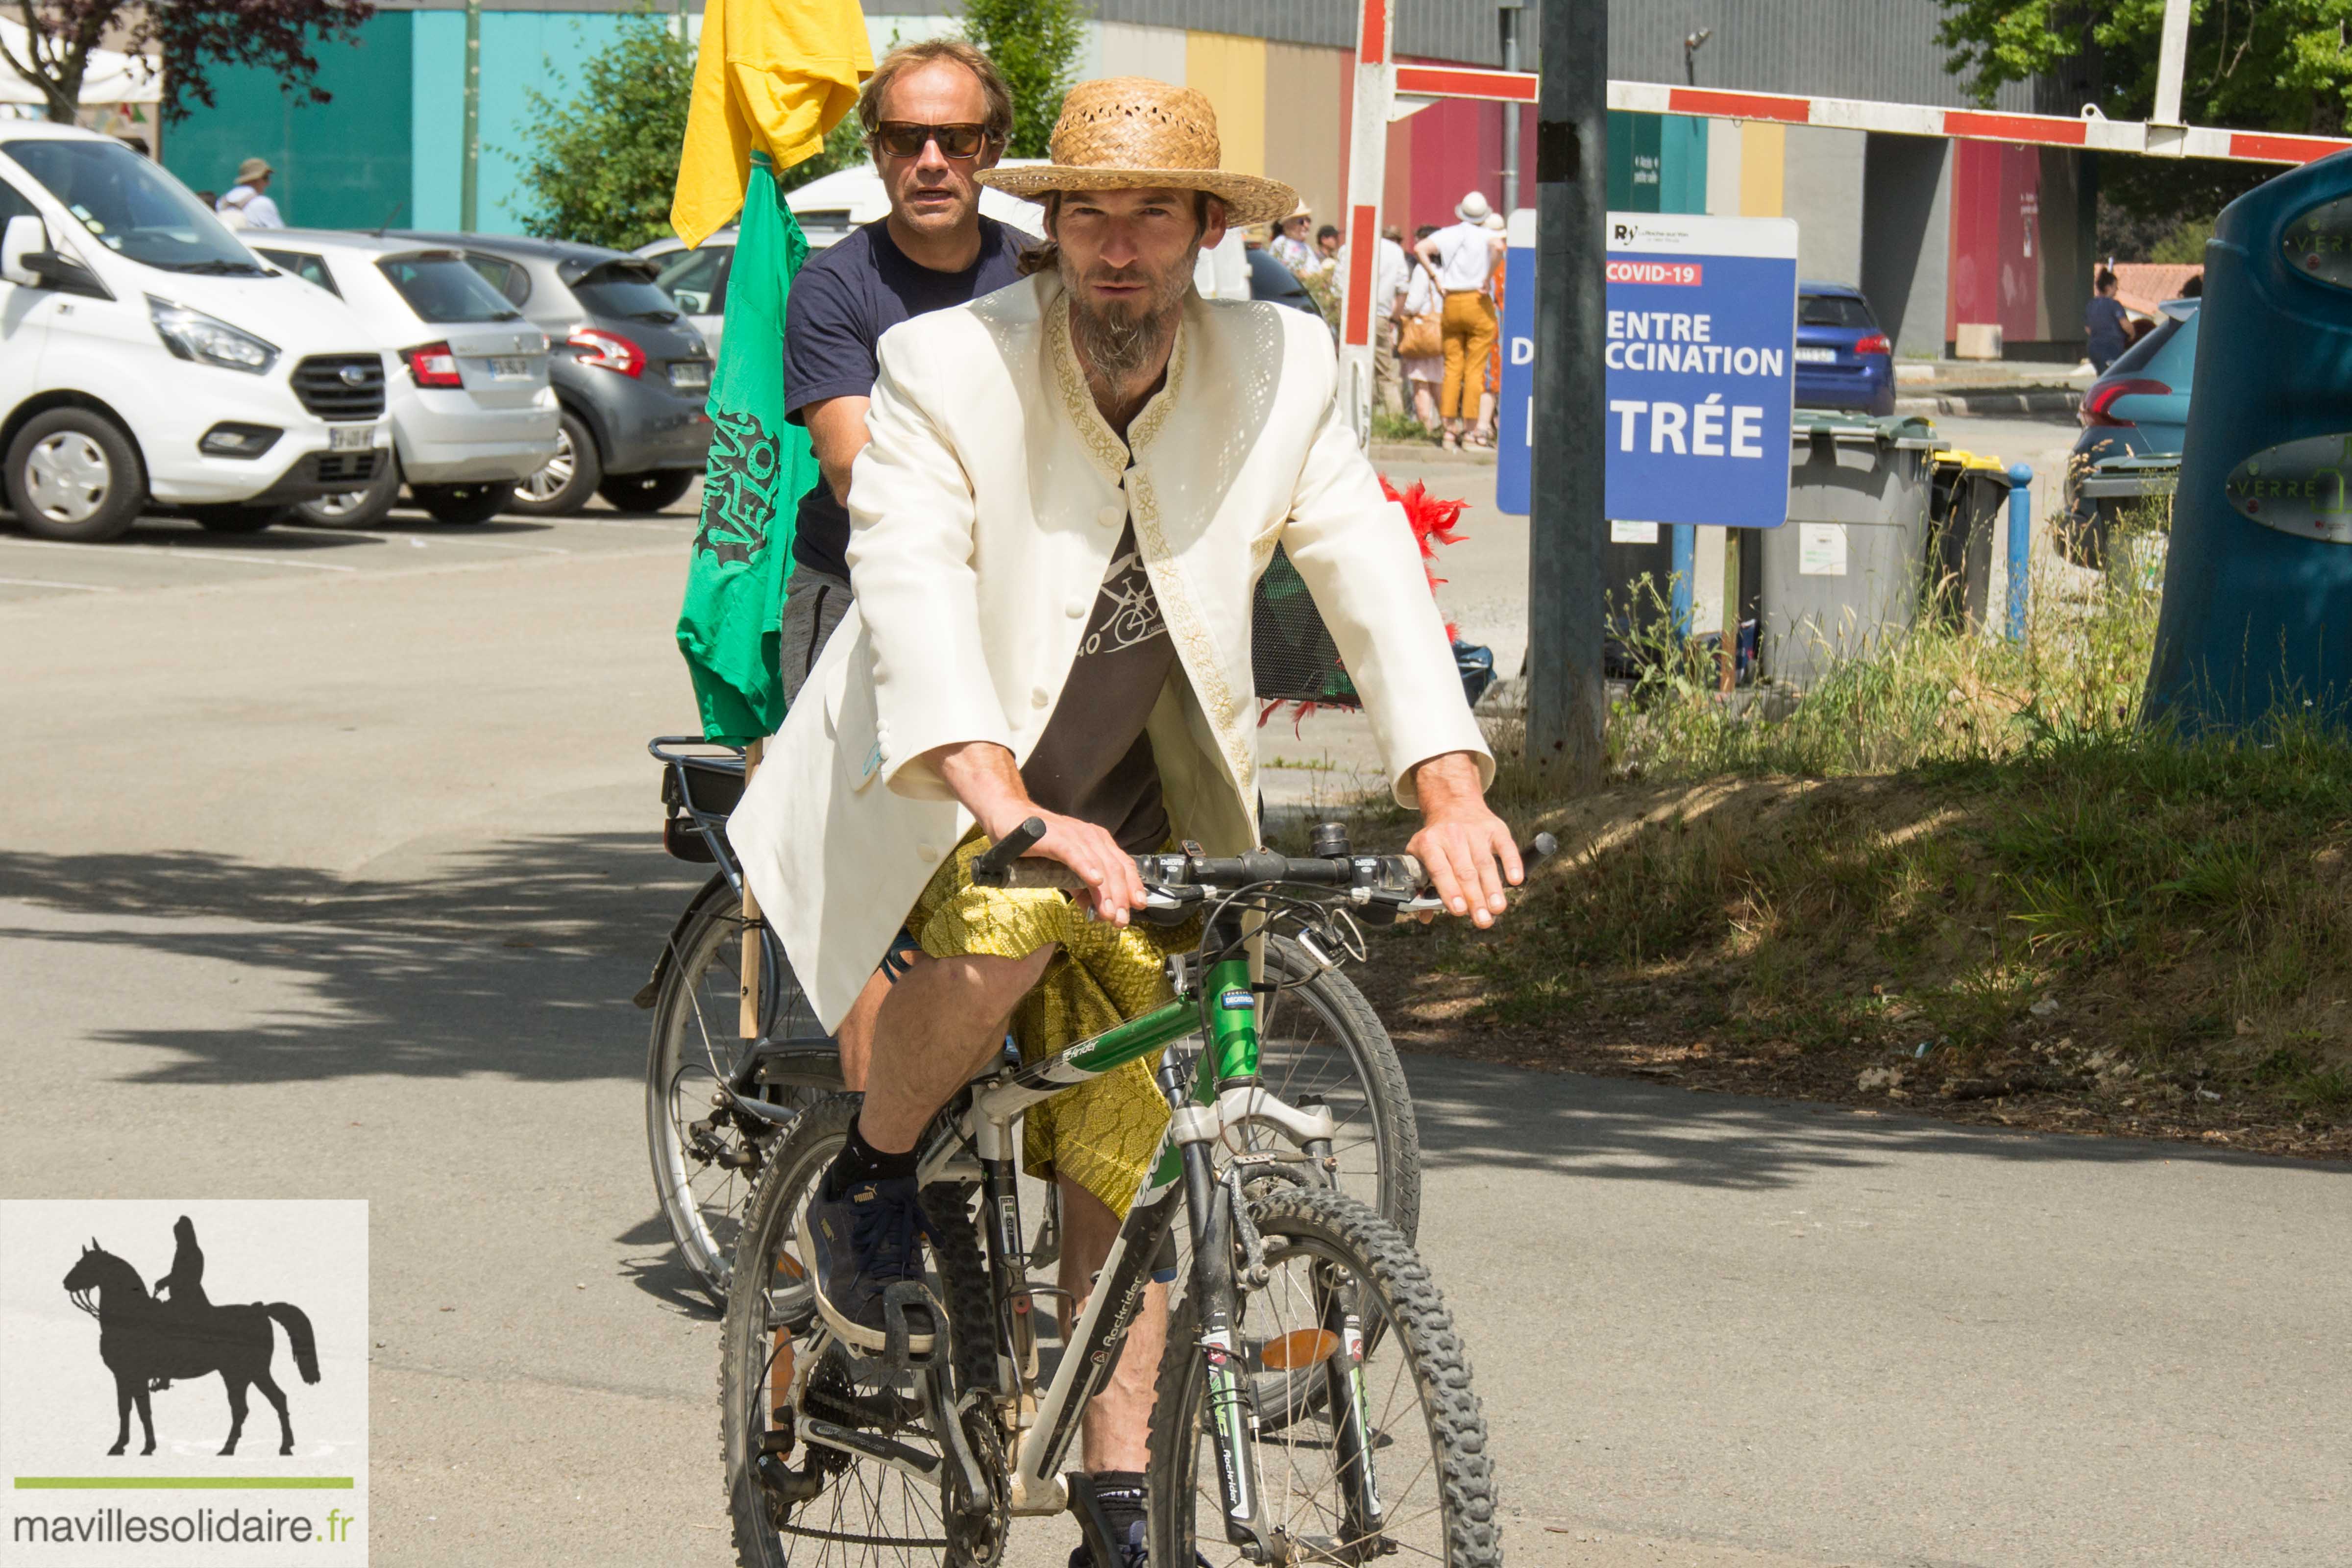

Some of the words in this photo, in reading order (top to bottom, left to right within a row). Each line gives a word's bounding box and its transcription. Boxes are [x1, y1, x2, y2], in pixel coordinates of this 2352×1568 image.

[2295, 235, 2352, 253] VER
[1606, 263, 1694, 283] COVID-19
[1607, 310, 1711, 343] ENTRE
[1511, 337, 1535, 365] D
[1605, 342, 1784, 377] CCINATION
[1525, 393, 1764, 458] TRÉE
[2236, 480, 2316, 497] VERRE
[854, 1192, 875, 1203] PUMA
[1102, 1275, 1142, 1347] Rockrider
[1223, 1449, 1238, 1504] Rockrider
